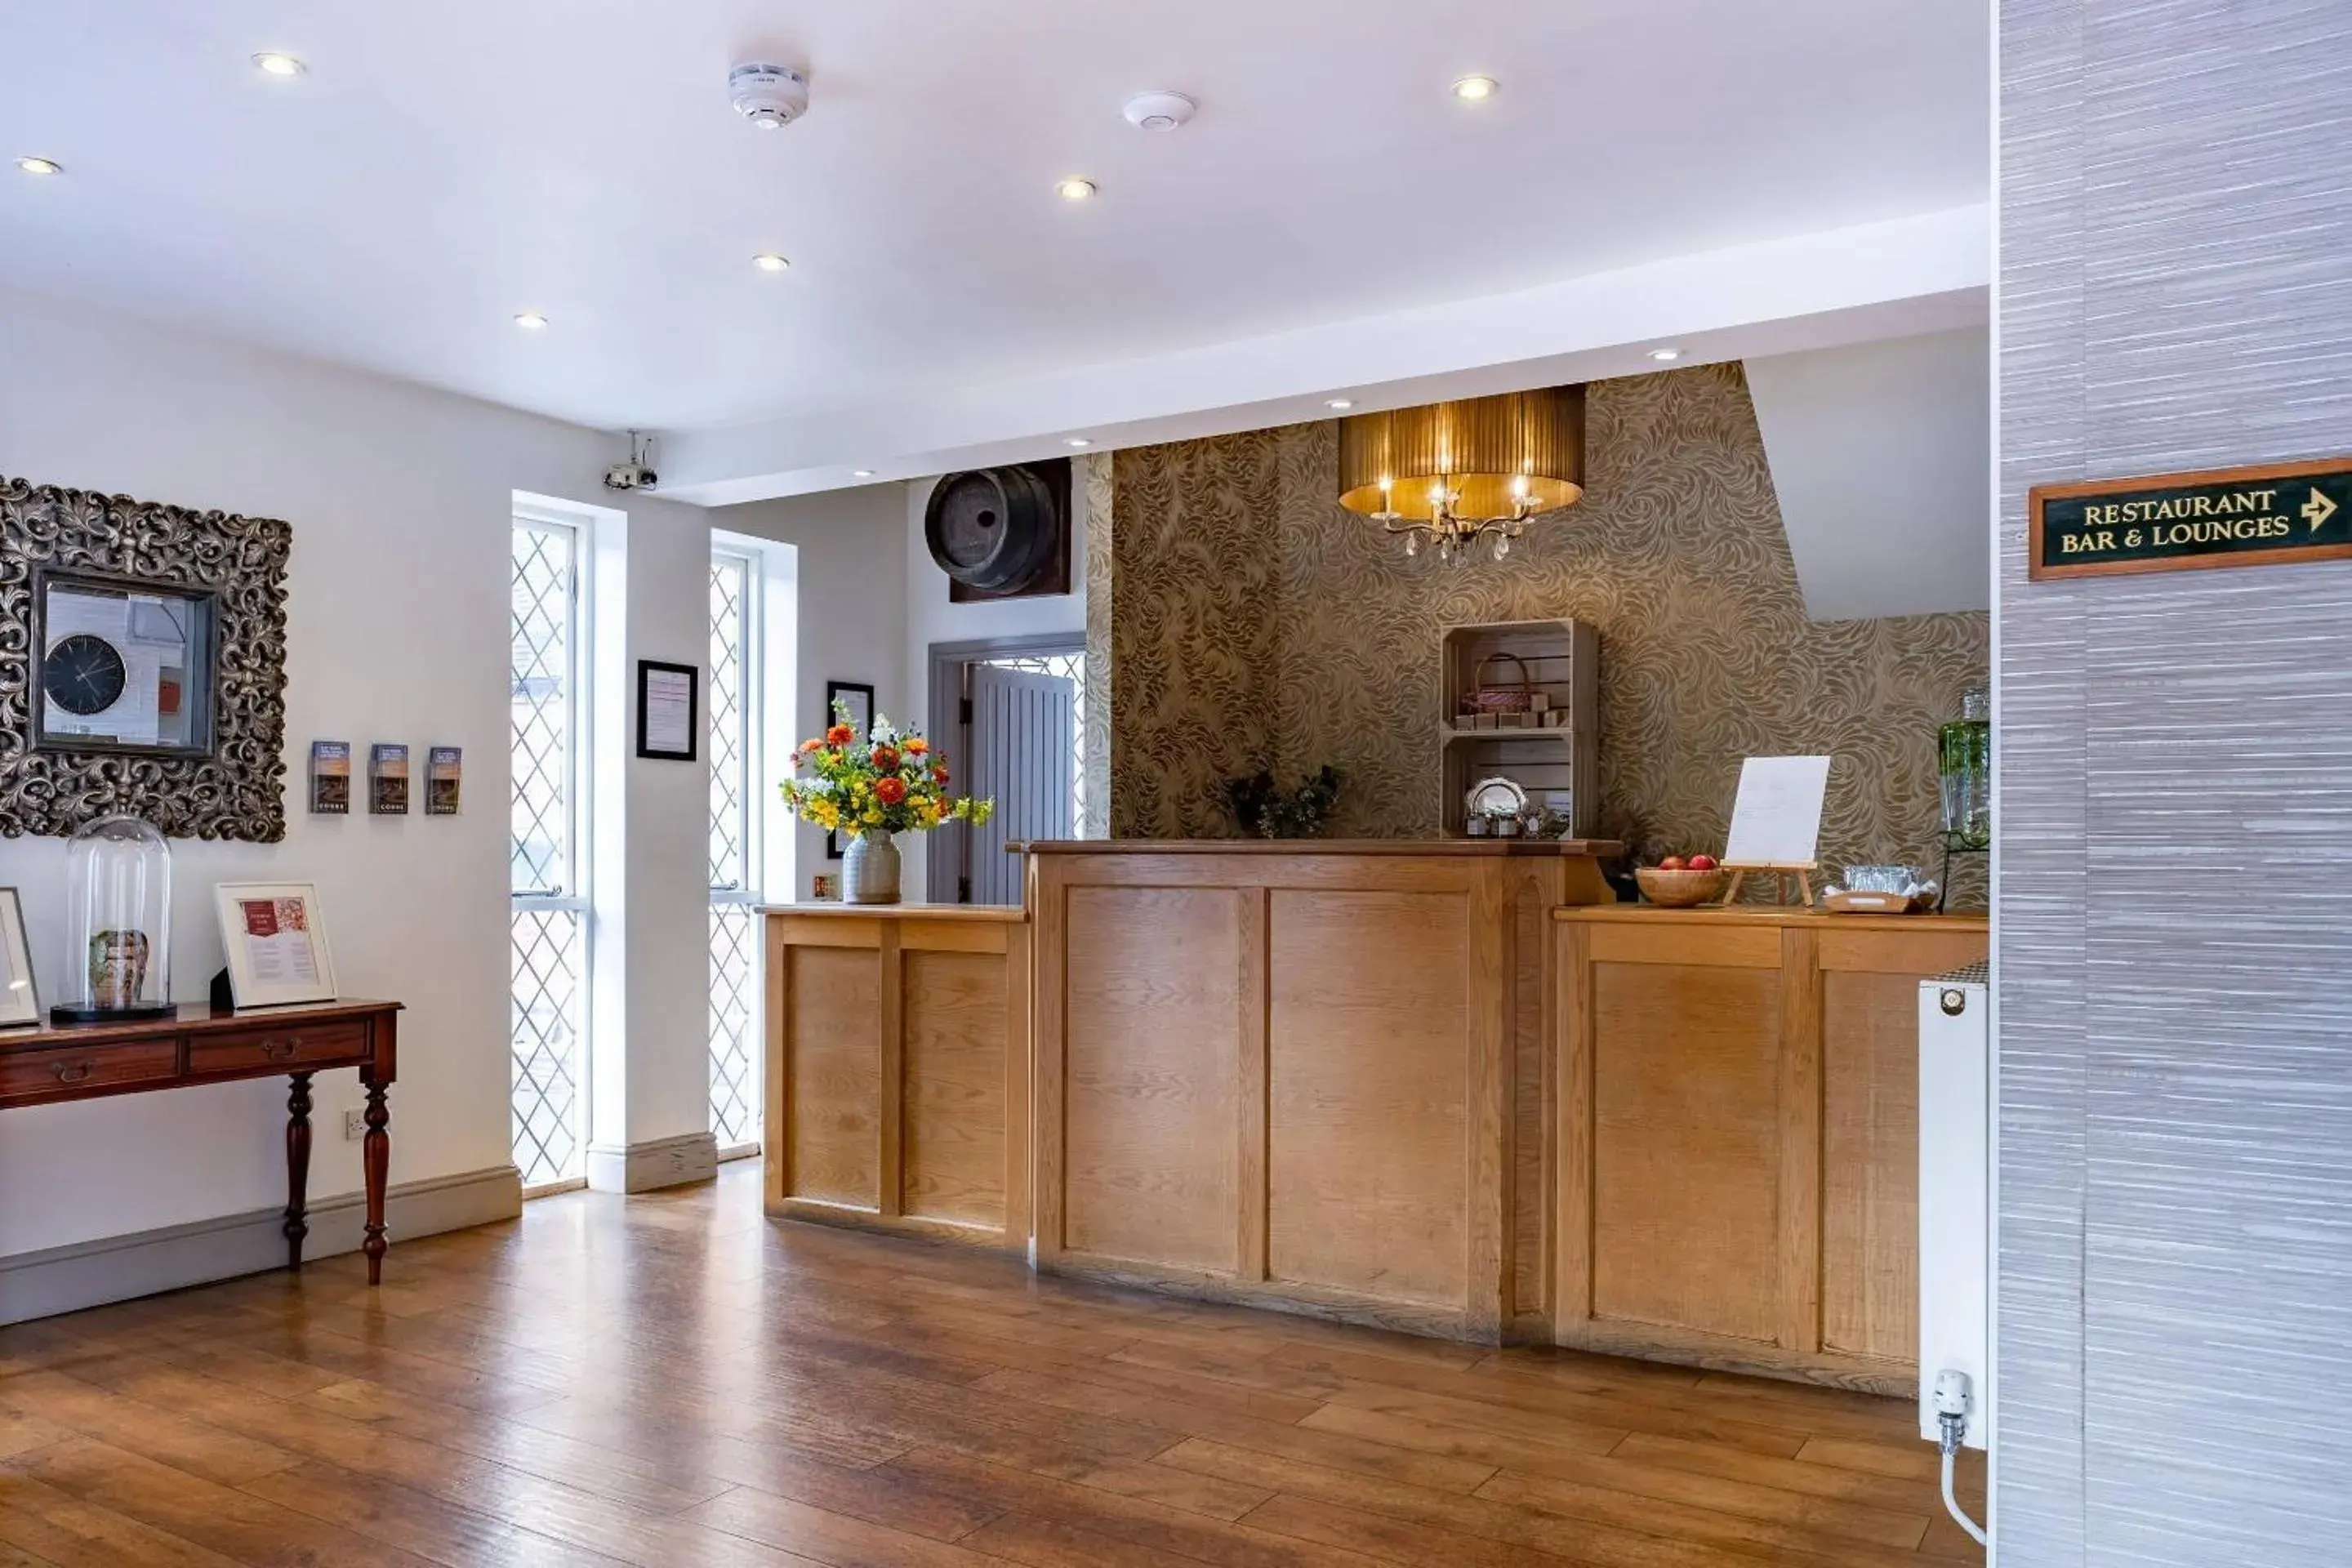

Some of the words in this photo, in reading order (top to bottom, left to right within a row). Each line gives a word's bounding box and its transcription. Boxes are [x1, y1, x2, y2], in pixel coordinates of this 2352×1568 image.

[2084, 491, 2276, 525] RESTAURANT
[2062, 532, 2116, 552] BAR
[2125, 530, 2142, 547] &
[2153, 516, 2288, 546] LOUNGES
